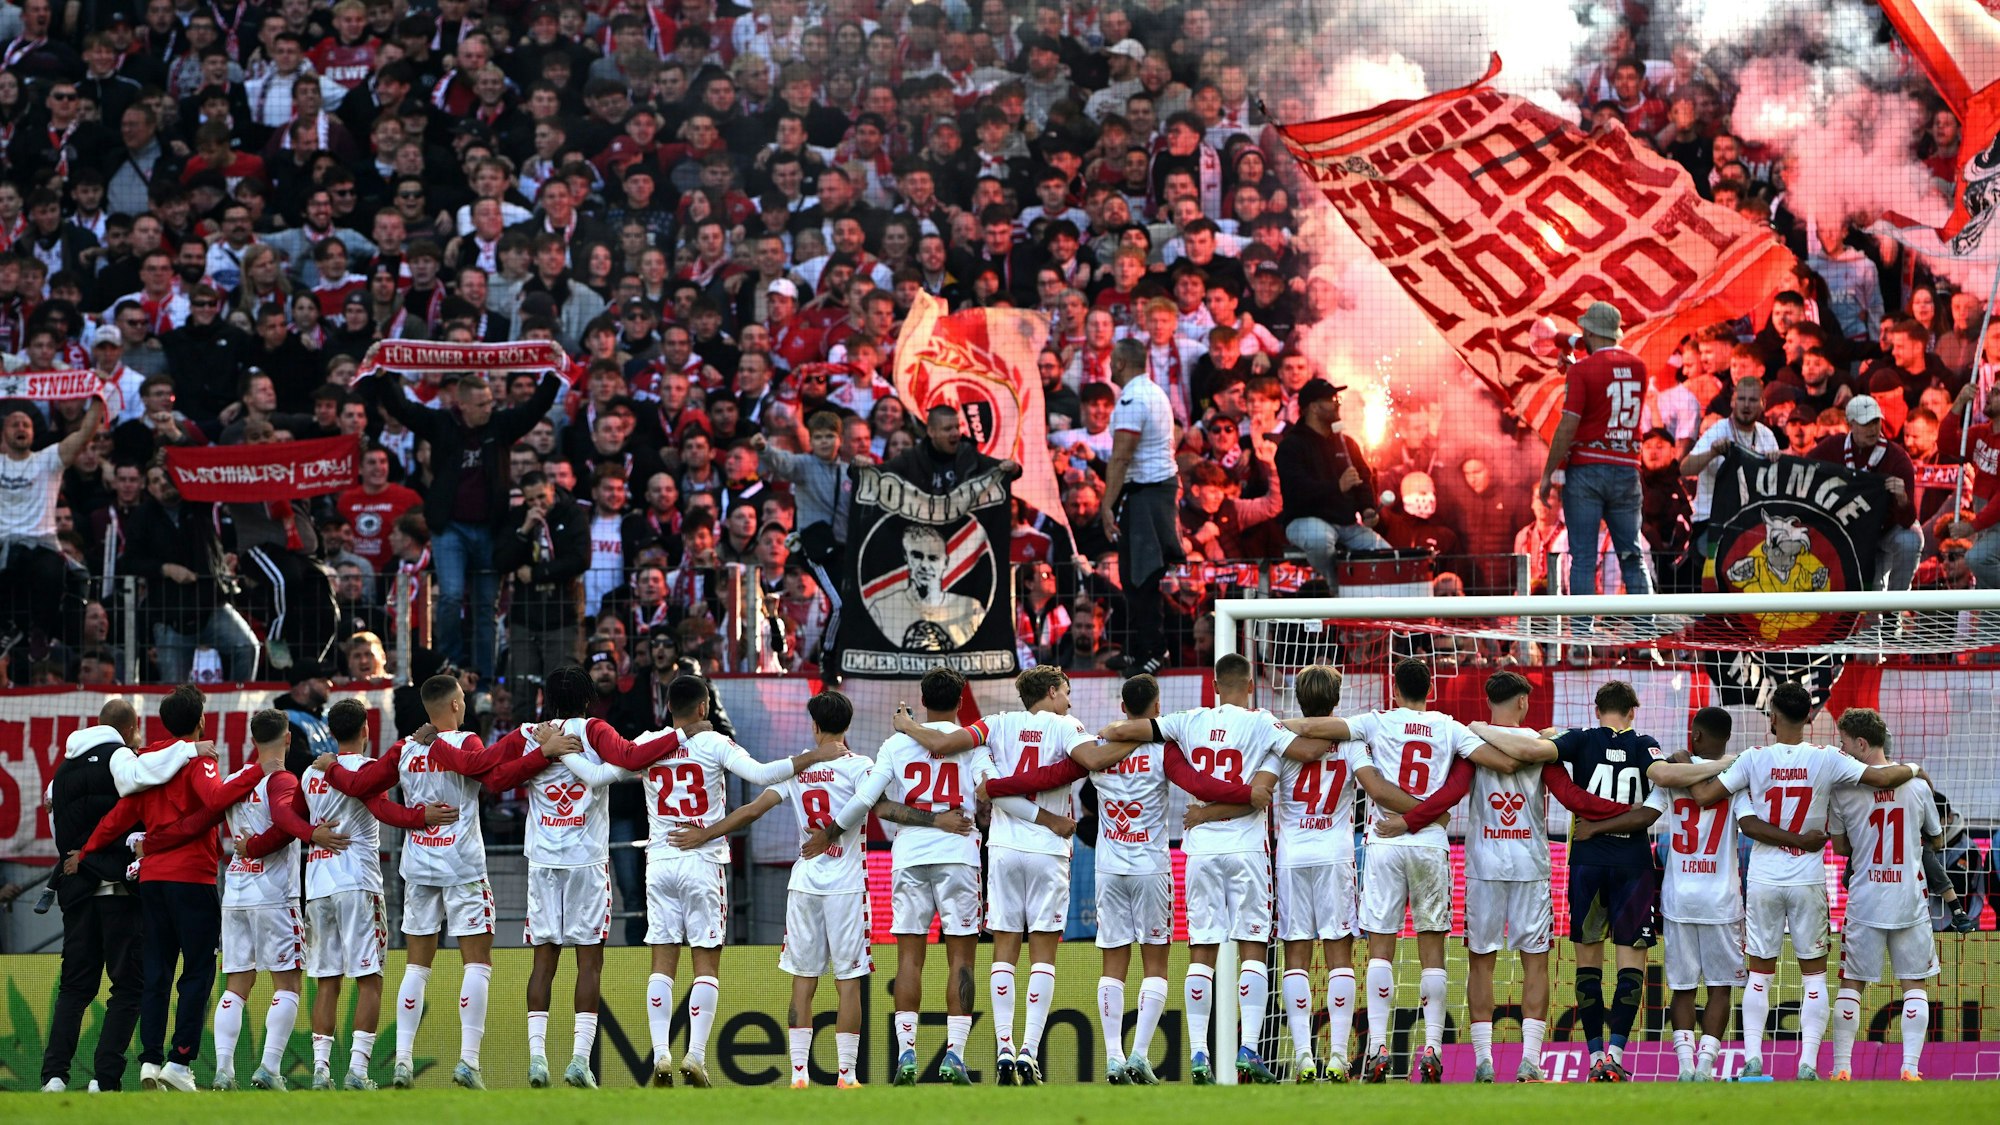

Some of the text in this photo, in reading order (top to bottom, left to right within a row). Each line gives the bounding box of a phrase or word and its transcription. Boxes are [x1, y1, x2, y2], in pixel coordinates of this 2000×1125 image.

[385, 345, 413, 363] FÜR
[417, 348, 462, 364] IMMER
[500, 347, 539, 363] KÖLN
[28, 373, 97, 396] SYNDIKA
[1606, 380, 1641, 429] 15
[846, 653, 897, 670] IMMER
[951, 654, 981, 671] VON
[986, 654, 1012, 670] UNS
[1404, 723, 1433, 738] MARTEL
[408, 755, 446, 773] REW
[1013, 745, 1040, 802] 4
[1398, 740, 1432, 796] 6
[648, 763, 710, 817] 23
[904, 761, 964, 812] 24
[1292, 759, 1347, 815] 47
[1586, 763, 1644, 805] 40
[1873, 789, 1896, 804] KAINZ
[541, 812, 587, 827] hummel
[801, 788, 833, 830] 8
[1764, 786, 1813, 834] 17
[411, 832, 456, 847] hummel
[1484, 825, 1533, 840] hummel
[1672, 797, 1730, 856] 37
[1868, 807, 1905, 865] 11
[1689, 861, 1697, 873] FC
[1698, 858, 1717, 874] KÖLN
[1874, 869, 1881, 882] FC
[1882, 867, 1902, 883] KÖLN
